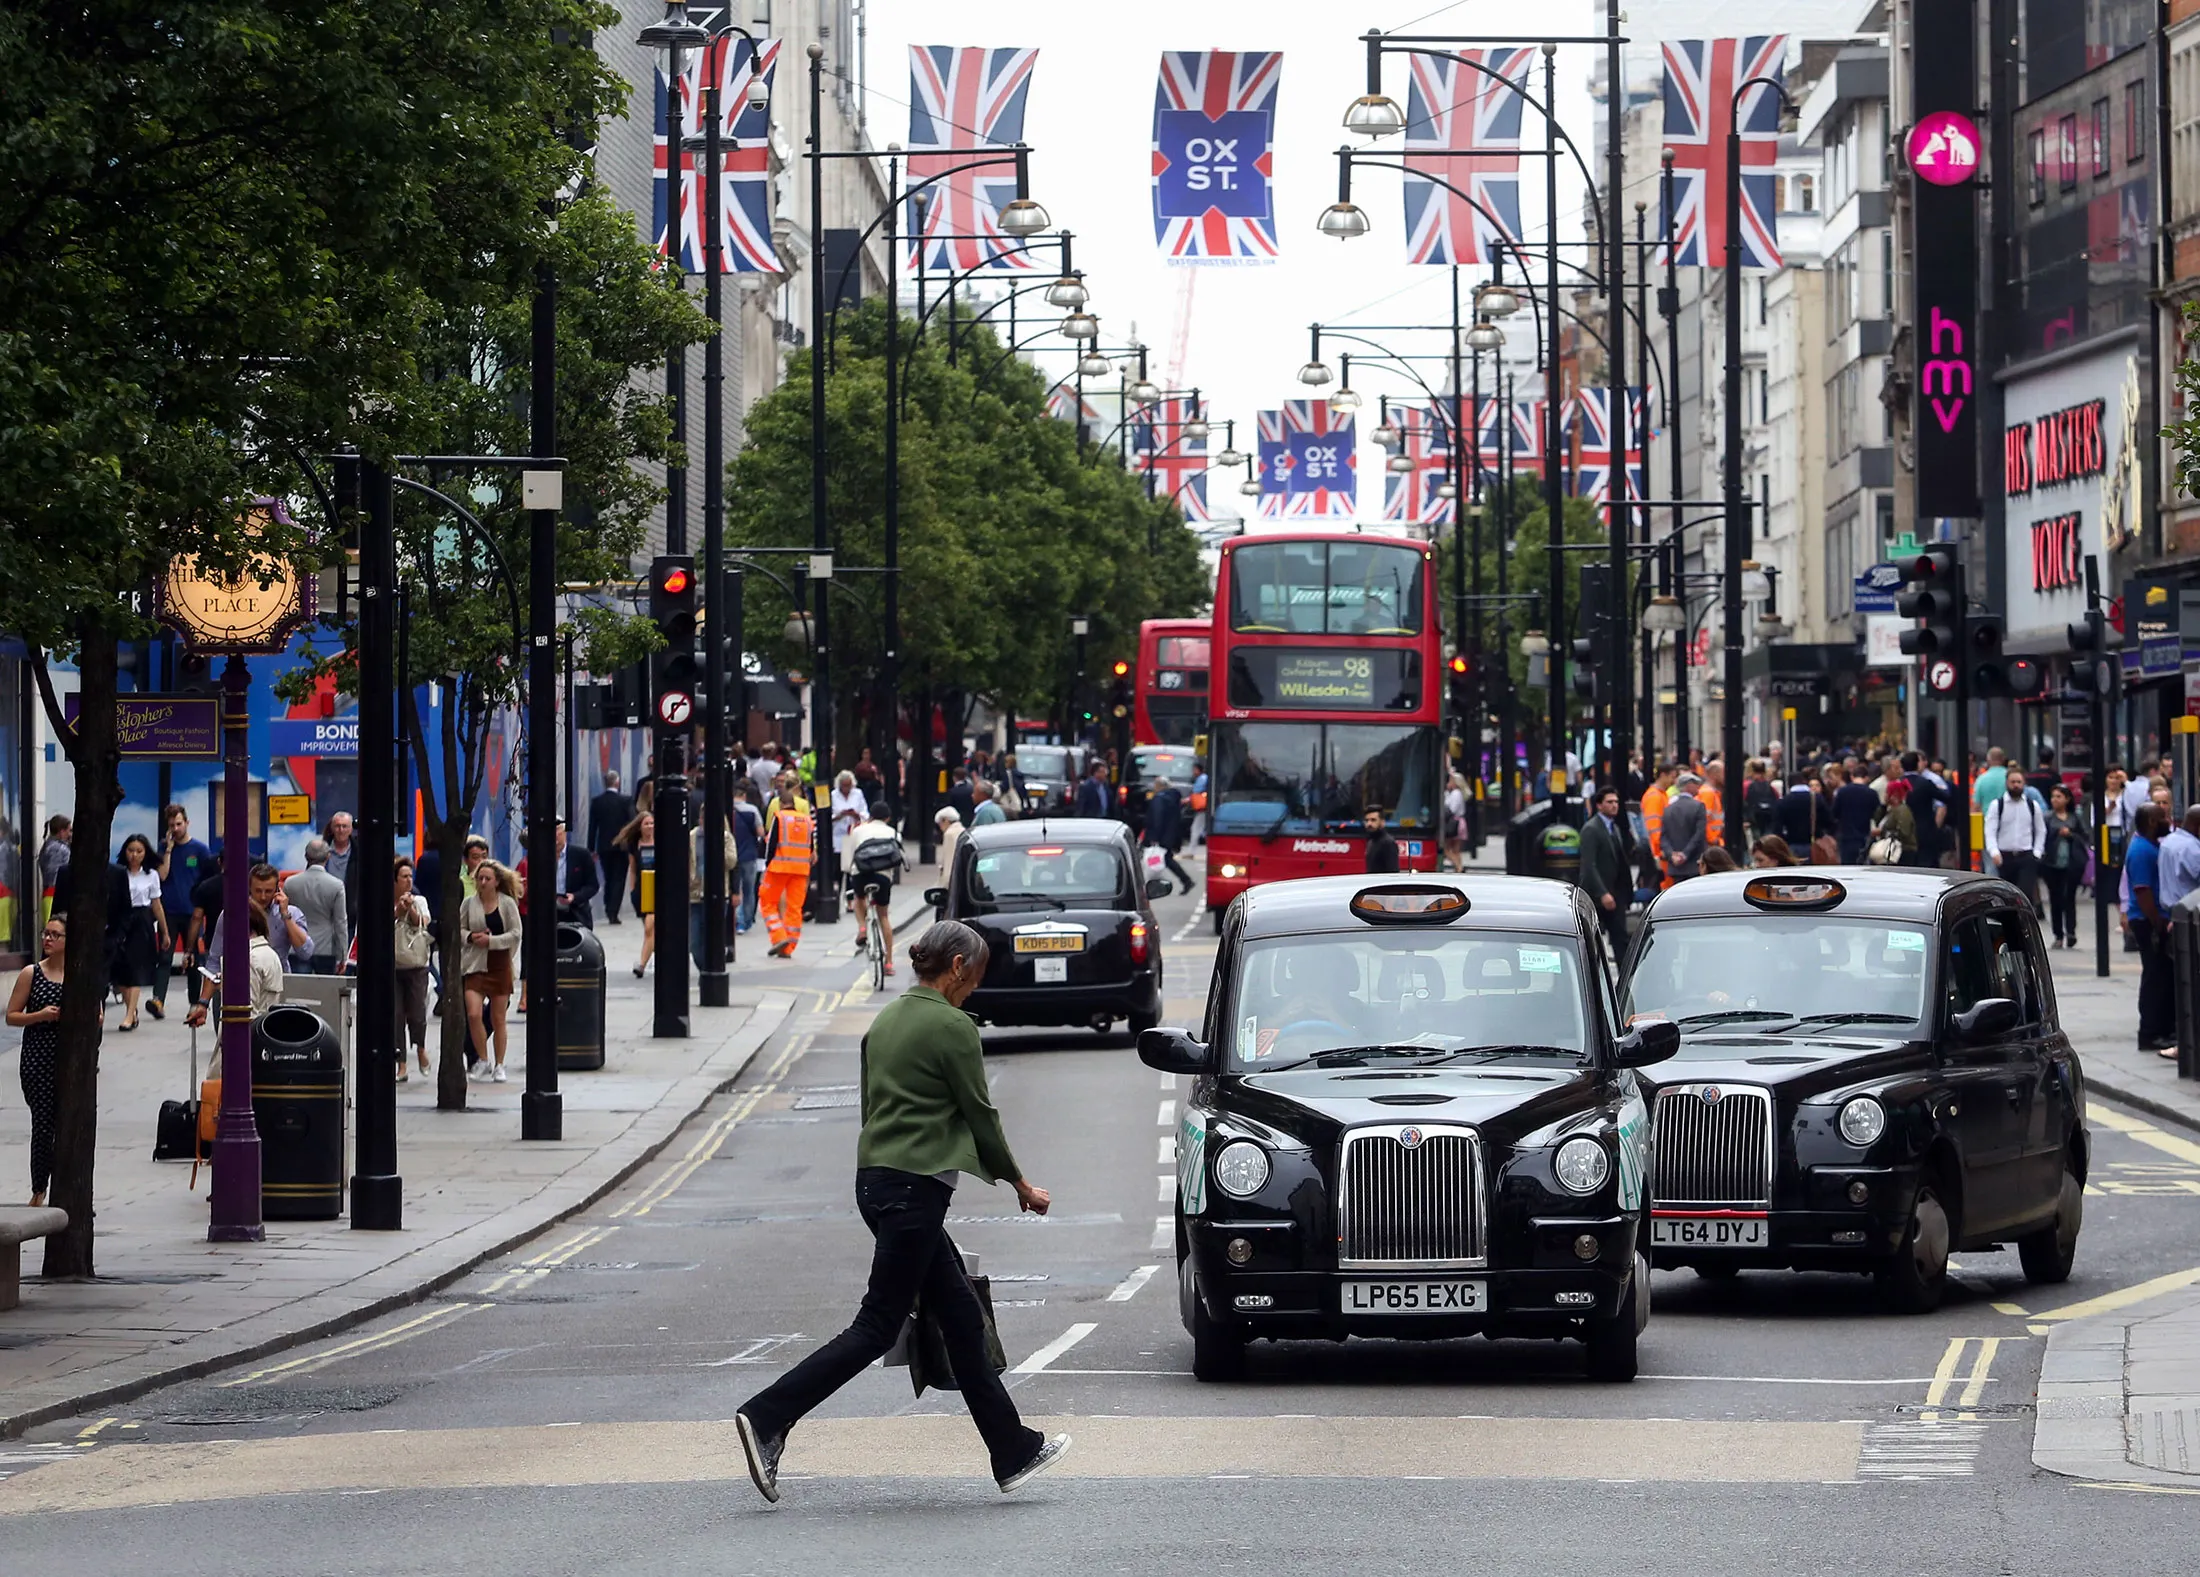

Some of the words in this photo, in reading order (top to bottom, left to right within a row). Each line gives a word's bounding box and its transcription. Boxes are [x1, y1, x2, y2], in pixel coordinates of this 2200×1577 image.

[1185, 137, 1238, 163] OX
[1187, 165, 1238, 190] ST.
[1922, 306, 1972, 433] hmv
[1304, 446, 1337, 462] OX
[2005, 423, 2029, 494] HIS
[1306, 462, 1338, 478] ST.
[2031, 513, 2079, 591] VOICE
[203, 598, 260, 613] PLACE
[1344, 658, 1370, 678] 98
[1280, 682, 1349, 697] Willesden
[154, 728, 182, 736] Boutique
[185, 742, 206, 750] Dining
[1293, 839, 1350, 853] Metroline
[1023, 938, 1048, 949] KD15
[1653, 1222, 1709, 1242] LT64
[1716, 1223, 1759, 1243] DYJ
[1353, 1285, 1419, 1308] LP65
[1426, 1284, 1476, 1307] EXG
